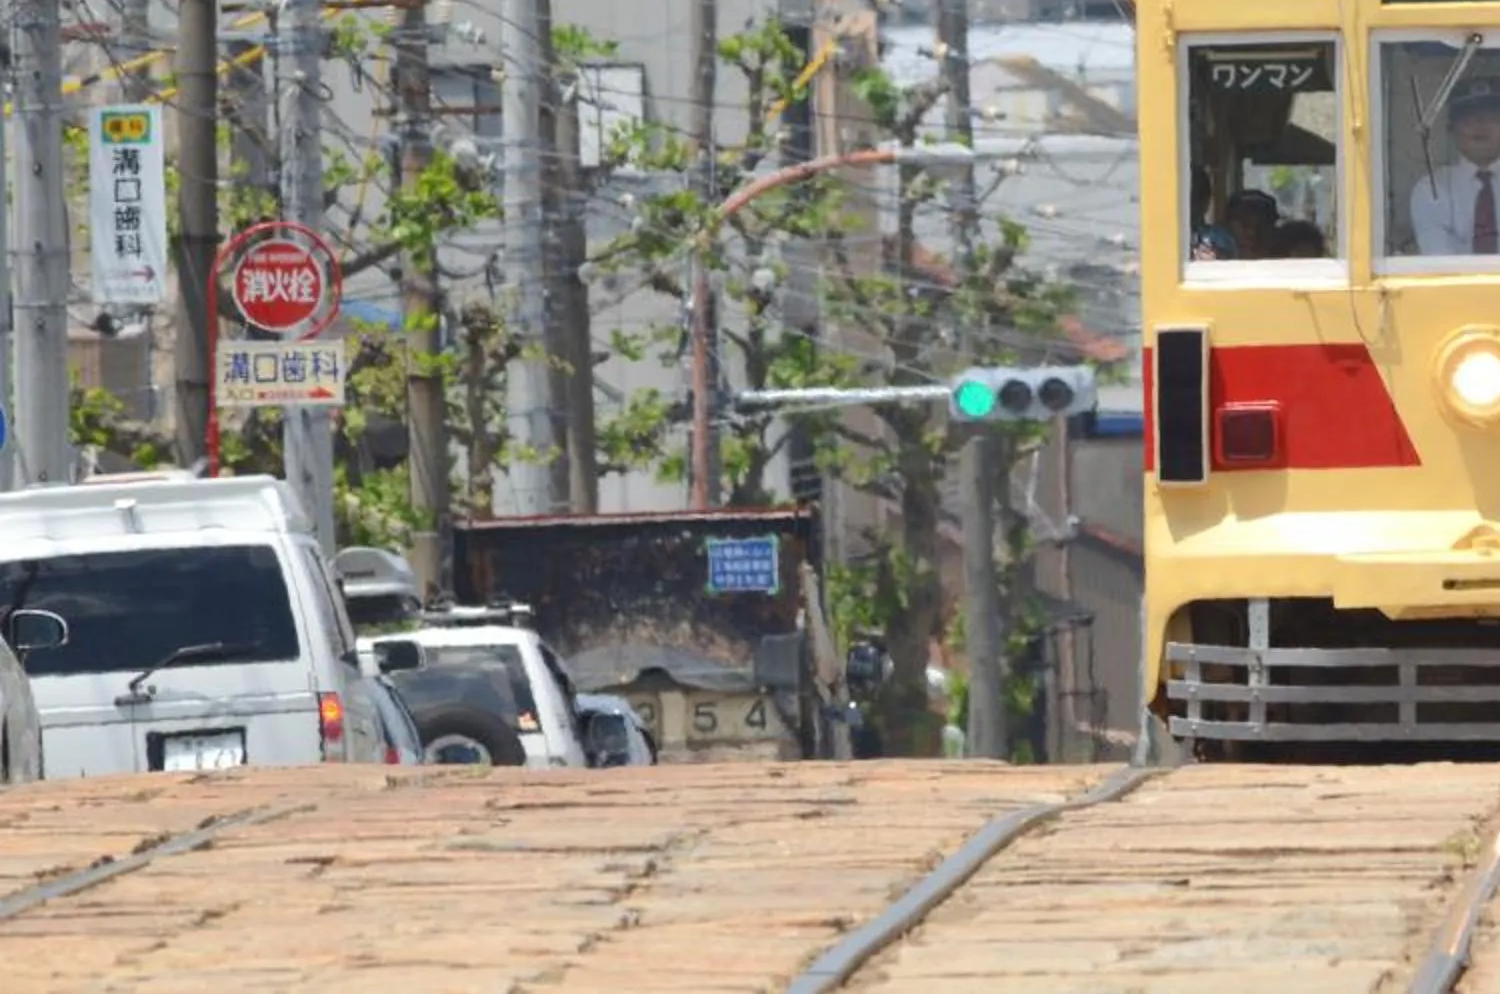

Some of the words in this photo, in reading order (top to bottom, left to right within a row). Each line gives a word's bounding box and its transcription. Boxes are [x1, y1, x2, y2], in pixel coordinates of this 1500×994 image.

[1212, 64, 1313, 88] ワンマン
[112, 147, 143, 260] 溝口歯科
[241, 268, 316, 303] 消火栓
[223, 350, 339, 384] 溝口歯科
